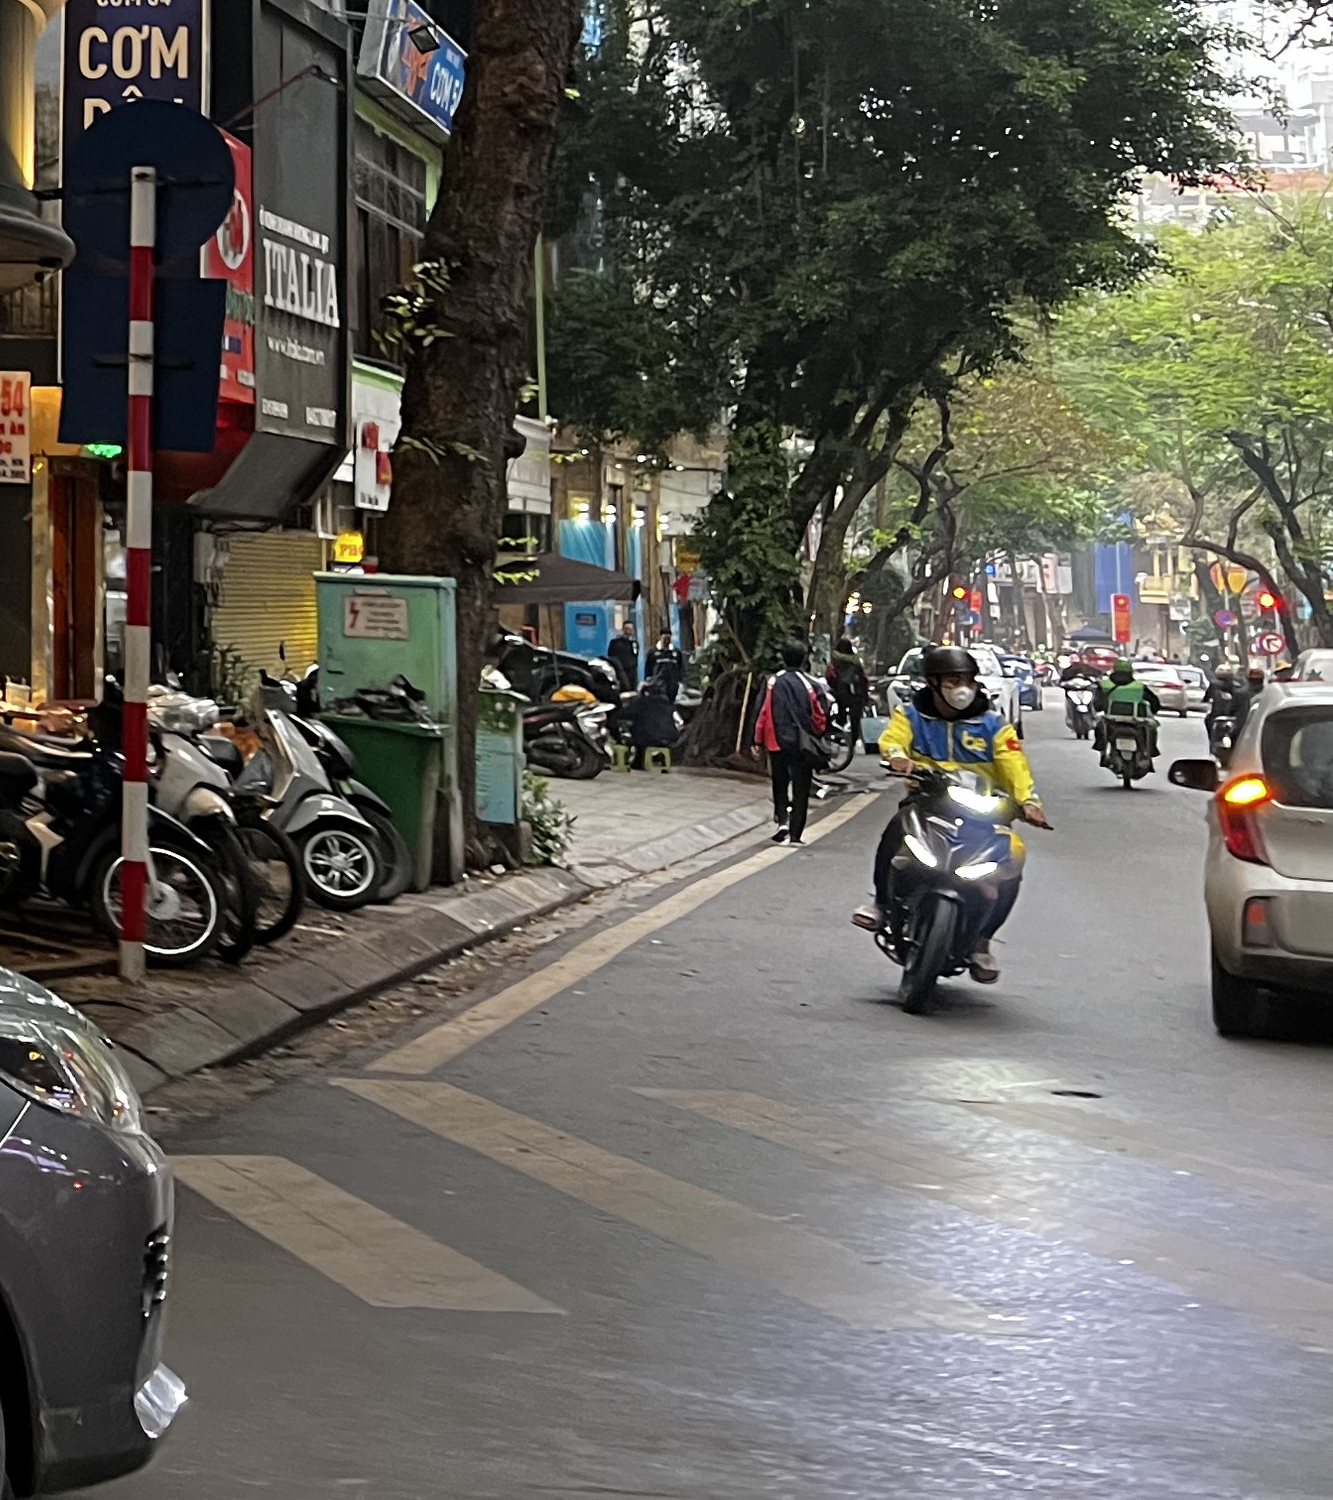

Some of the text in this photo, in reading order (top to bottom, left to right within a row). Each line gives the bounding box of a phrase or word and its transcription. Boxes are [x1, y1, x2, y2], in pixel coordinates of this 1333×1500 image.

[79, 25, 189, 79] CƠM
[263, 237, 340, 329] ITALIA
[1, 378, 24, 417] 54
